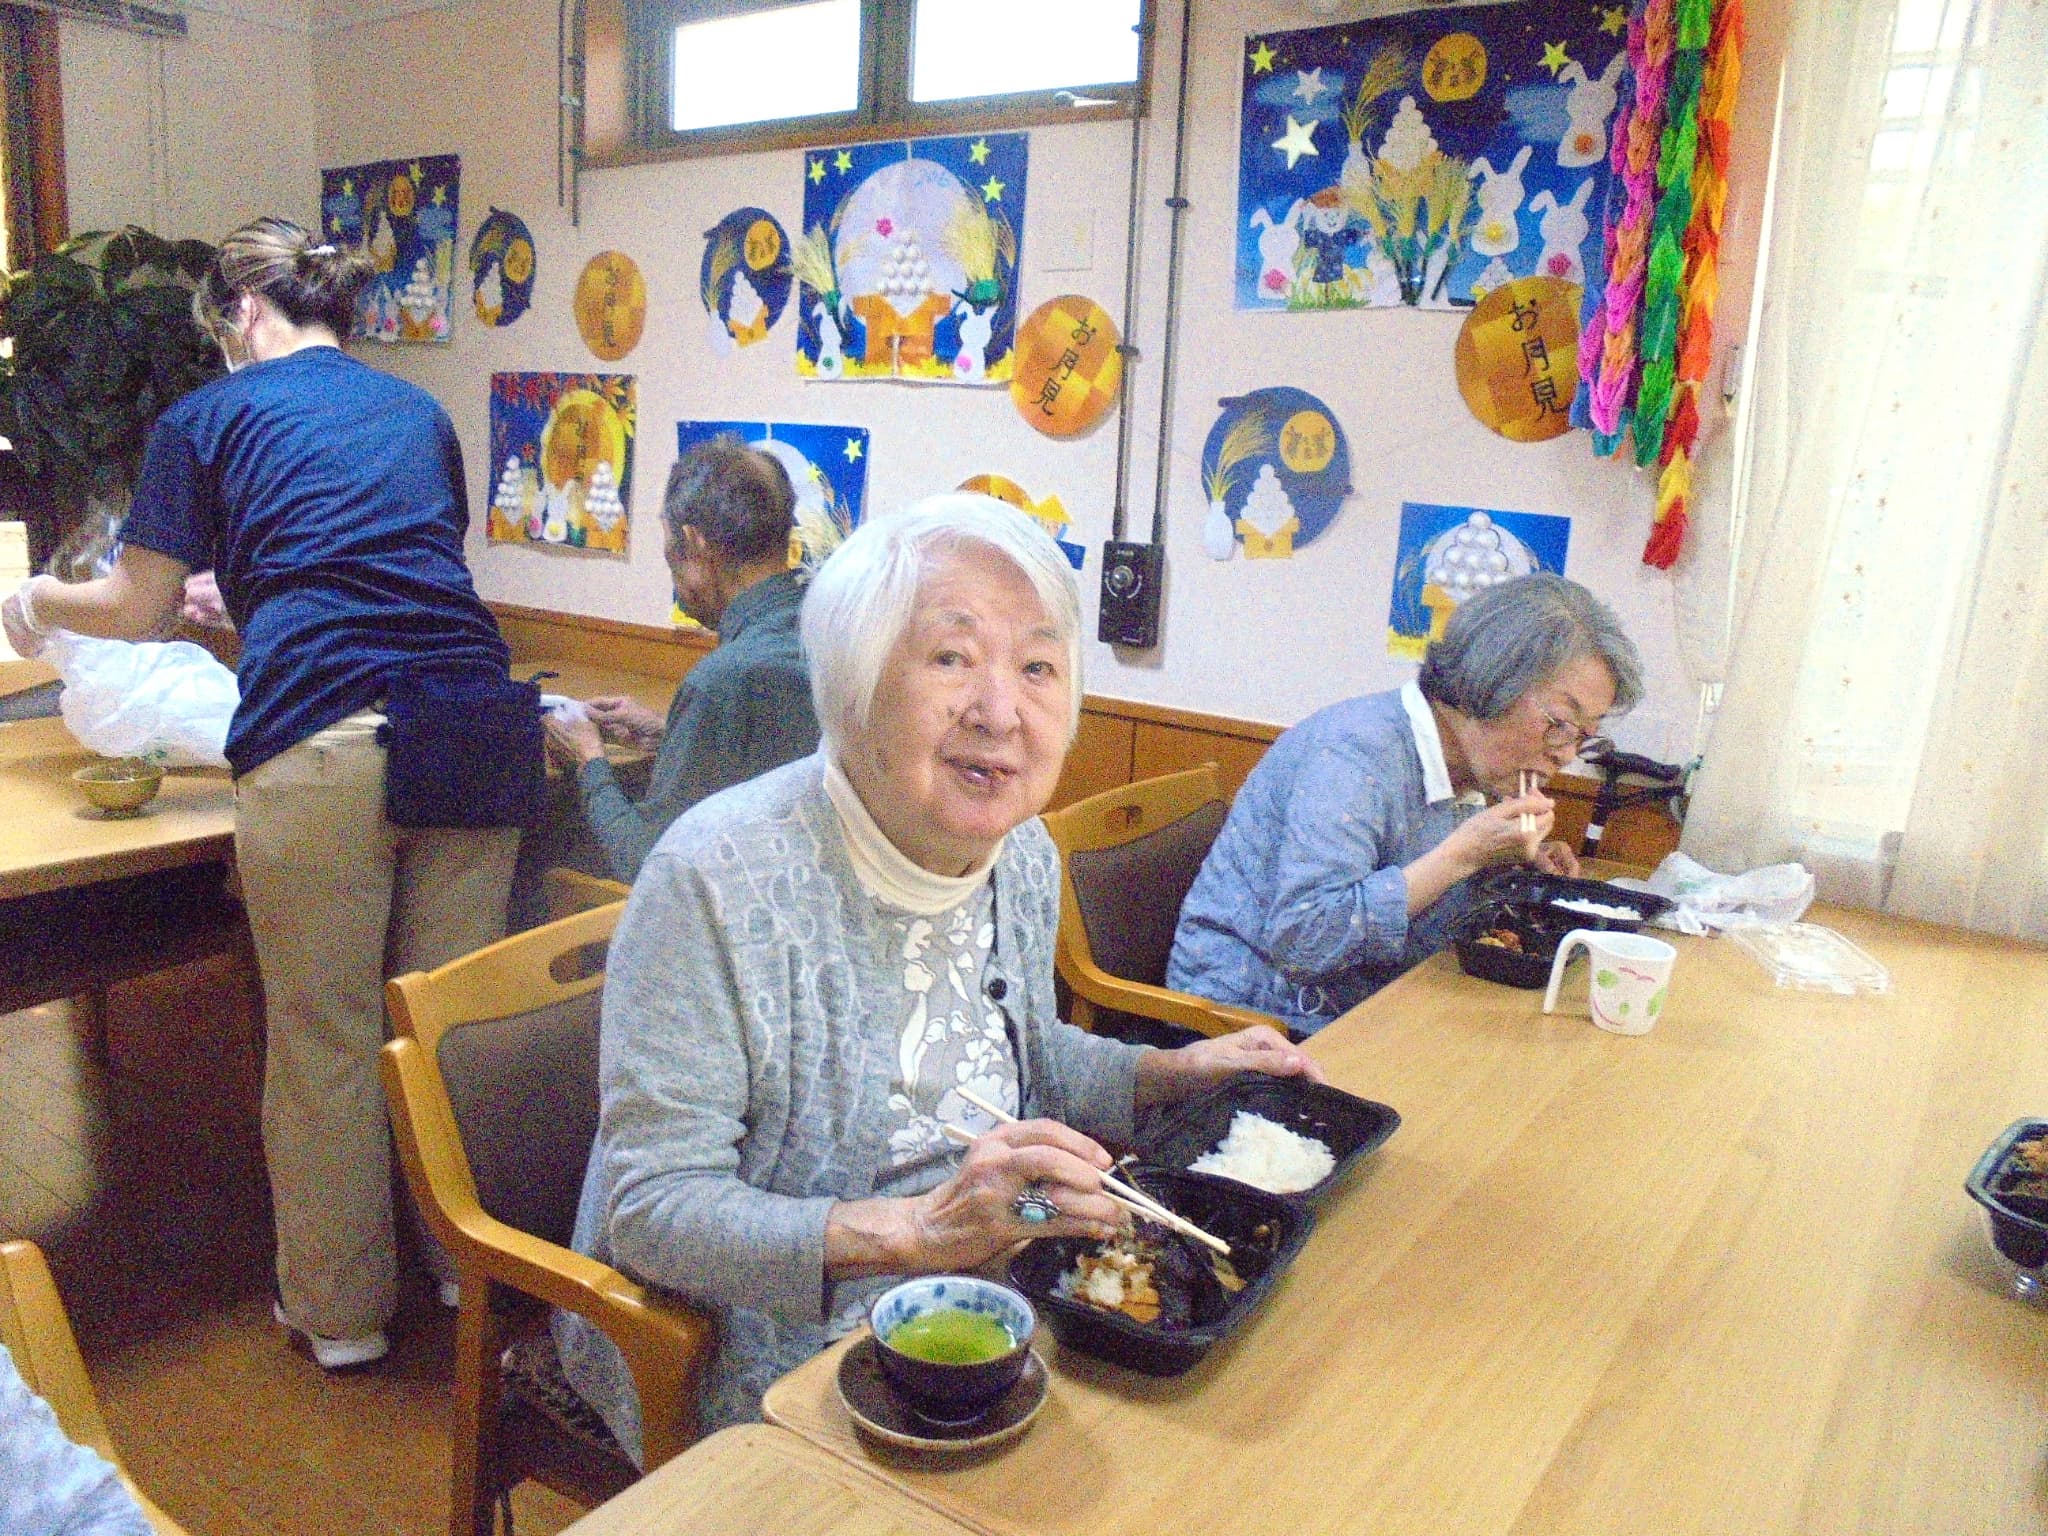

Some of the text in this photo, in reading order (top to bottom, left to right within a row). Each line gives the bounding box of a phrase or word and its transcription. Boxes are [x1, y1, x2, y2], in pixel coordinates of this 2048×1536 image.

[1030, 316, 1097, 416] お月見
[1508, 298, 1571, 421] お月見
